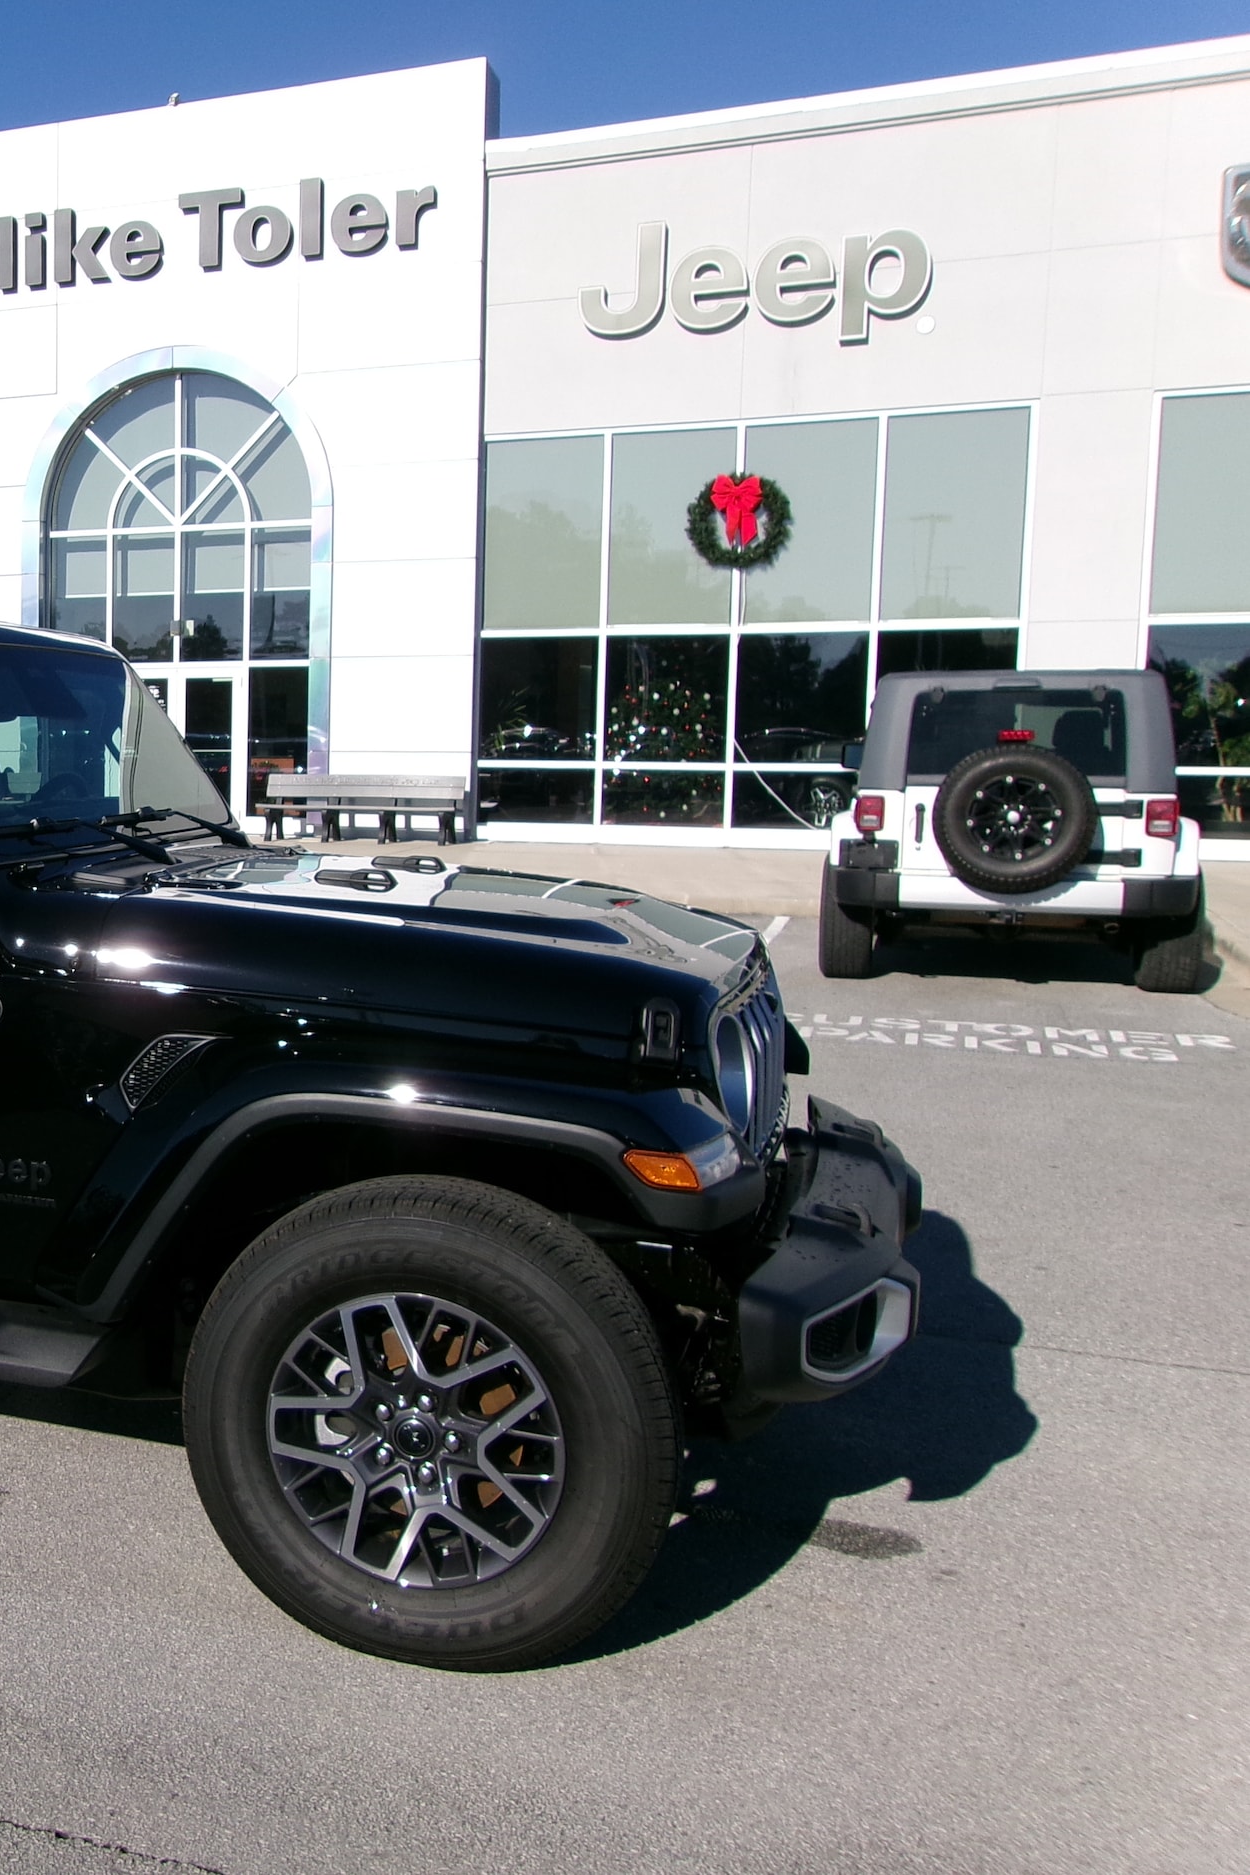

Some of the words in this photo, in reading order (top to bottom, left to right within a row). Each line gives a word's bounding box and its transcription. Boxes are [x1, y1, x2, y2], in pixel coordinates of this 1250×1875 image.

[178, 176, 438, 272] Toler
[577, 219, 933, 346] Jeep
[799, 1025, 1179, 1062] PARKING
